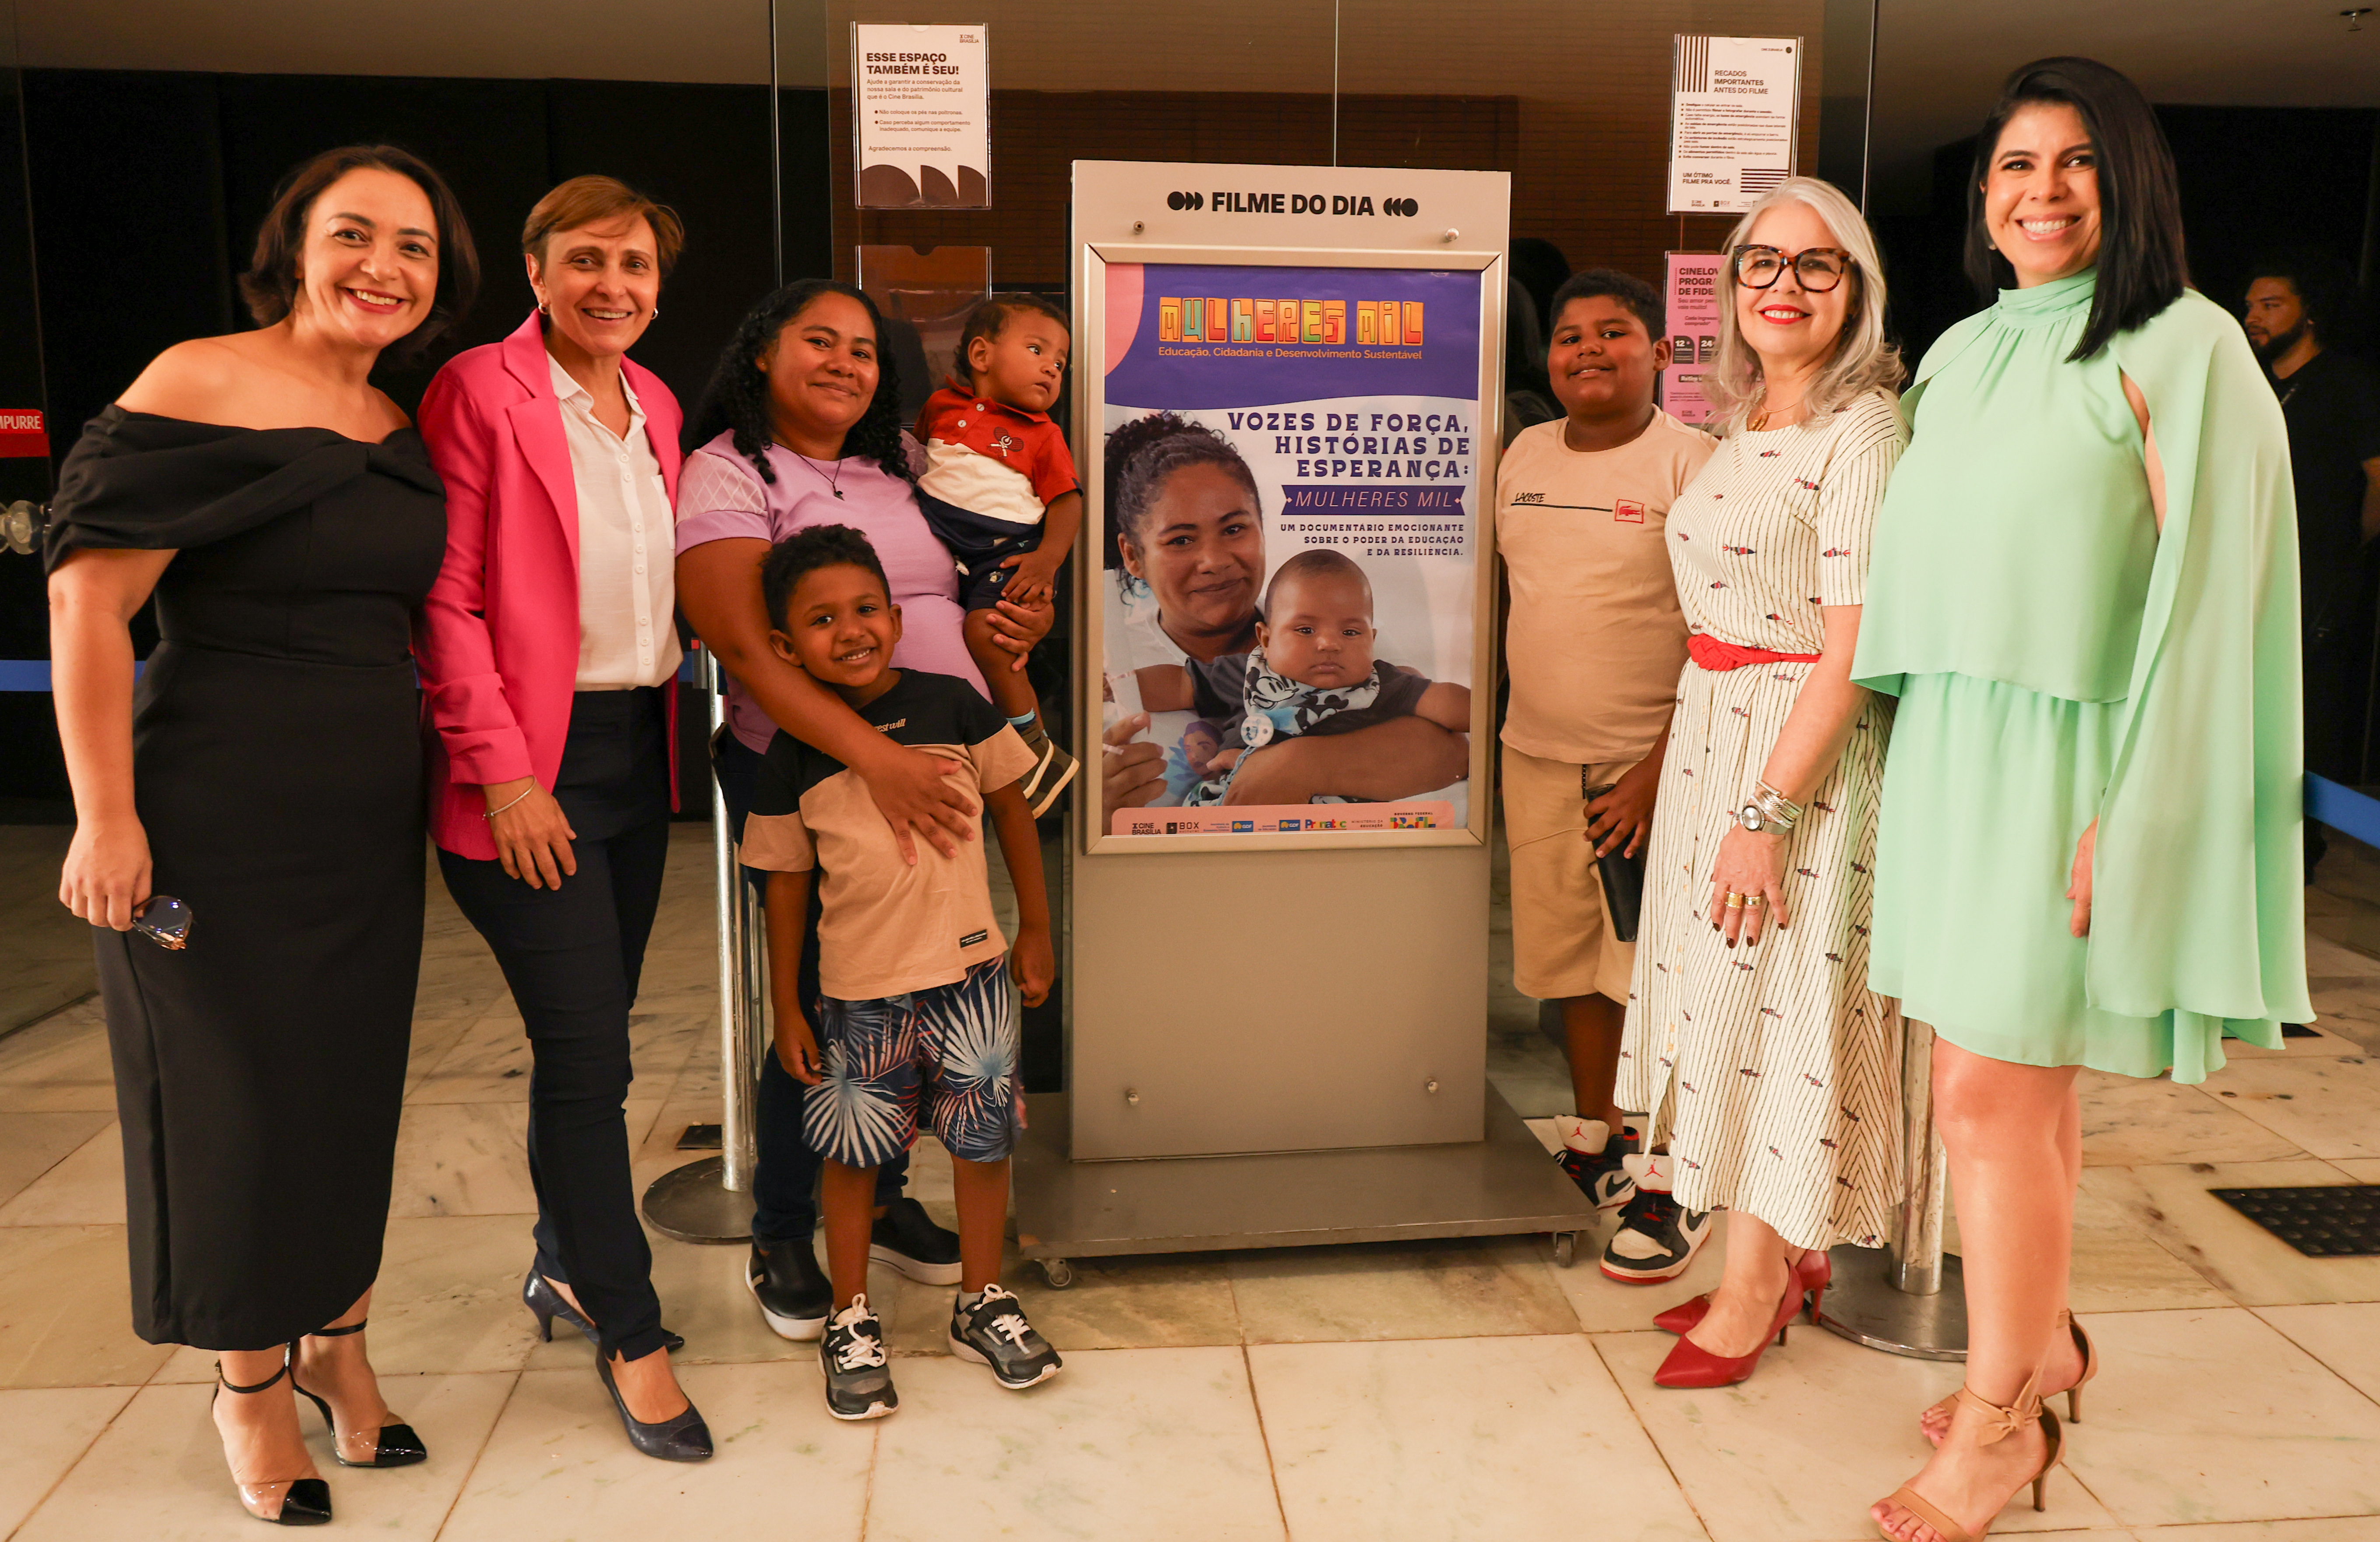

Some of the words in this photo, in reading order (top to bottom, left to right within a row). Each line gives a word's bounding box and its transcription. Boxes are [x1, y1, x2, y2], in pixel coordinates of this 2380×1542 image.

[866, 53, 896, 62] ESSE
[899, 53, 946, 64] ESPAÇO
[866, 64, 919, 74] TAMBÉM
[923, 64, 929, 74] É
[932, 66, 959, 74] SEU!
[1212, 192, 1285, 213] FILME
[1292, 194, 1326, 215] DO
[1332, 195, 1374, 216] DIA
[1158, 347, 1211, 358] Educação,
[1213, 348, 1264, 357] Cidadania
[1275, 349, 1361, 358] Desenvolvimento
[1363, 350, 1422, 360] Sustentável
[1227, 412, 1314, 430] VOZES
[1327, 413, 1358, 431] DE
[1371, 414, 1468, 435] FORÇA,
[1275, 433, 1427, 455] HISTÓRIAS
[1438, 438, 1469, 455] DE
[1297, 459, 1468, 481] ESPERANÇA:
[1296, 491, 1409, 507] MULHERES
[1418, 492, 1453, 507] MIL
[1515, 492, 1546, 503] LACOSTE
[1299, 522, 1384, 532] DOCUMENTÁRIO
[889, 718, 906, 730] will
[1390, 817, 1436, 829] BRASIL
